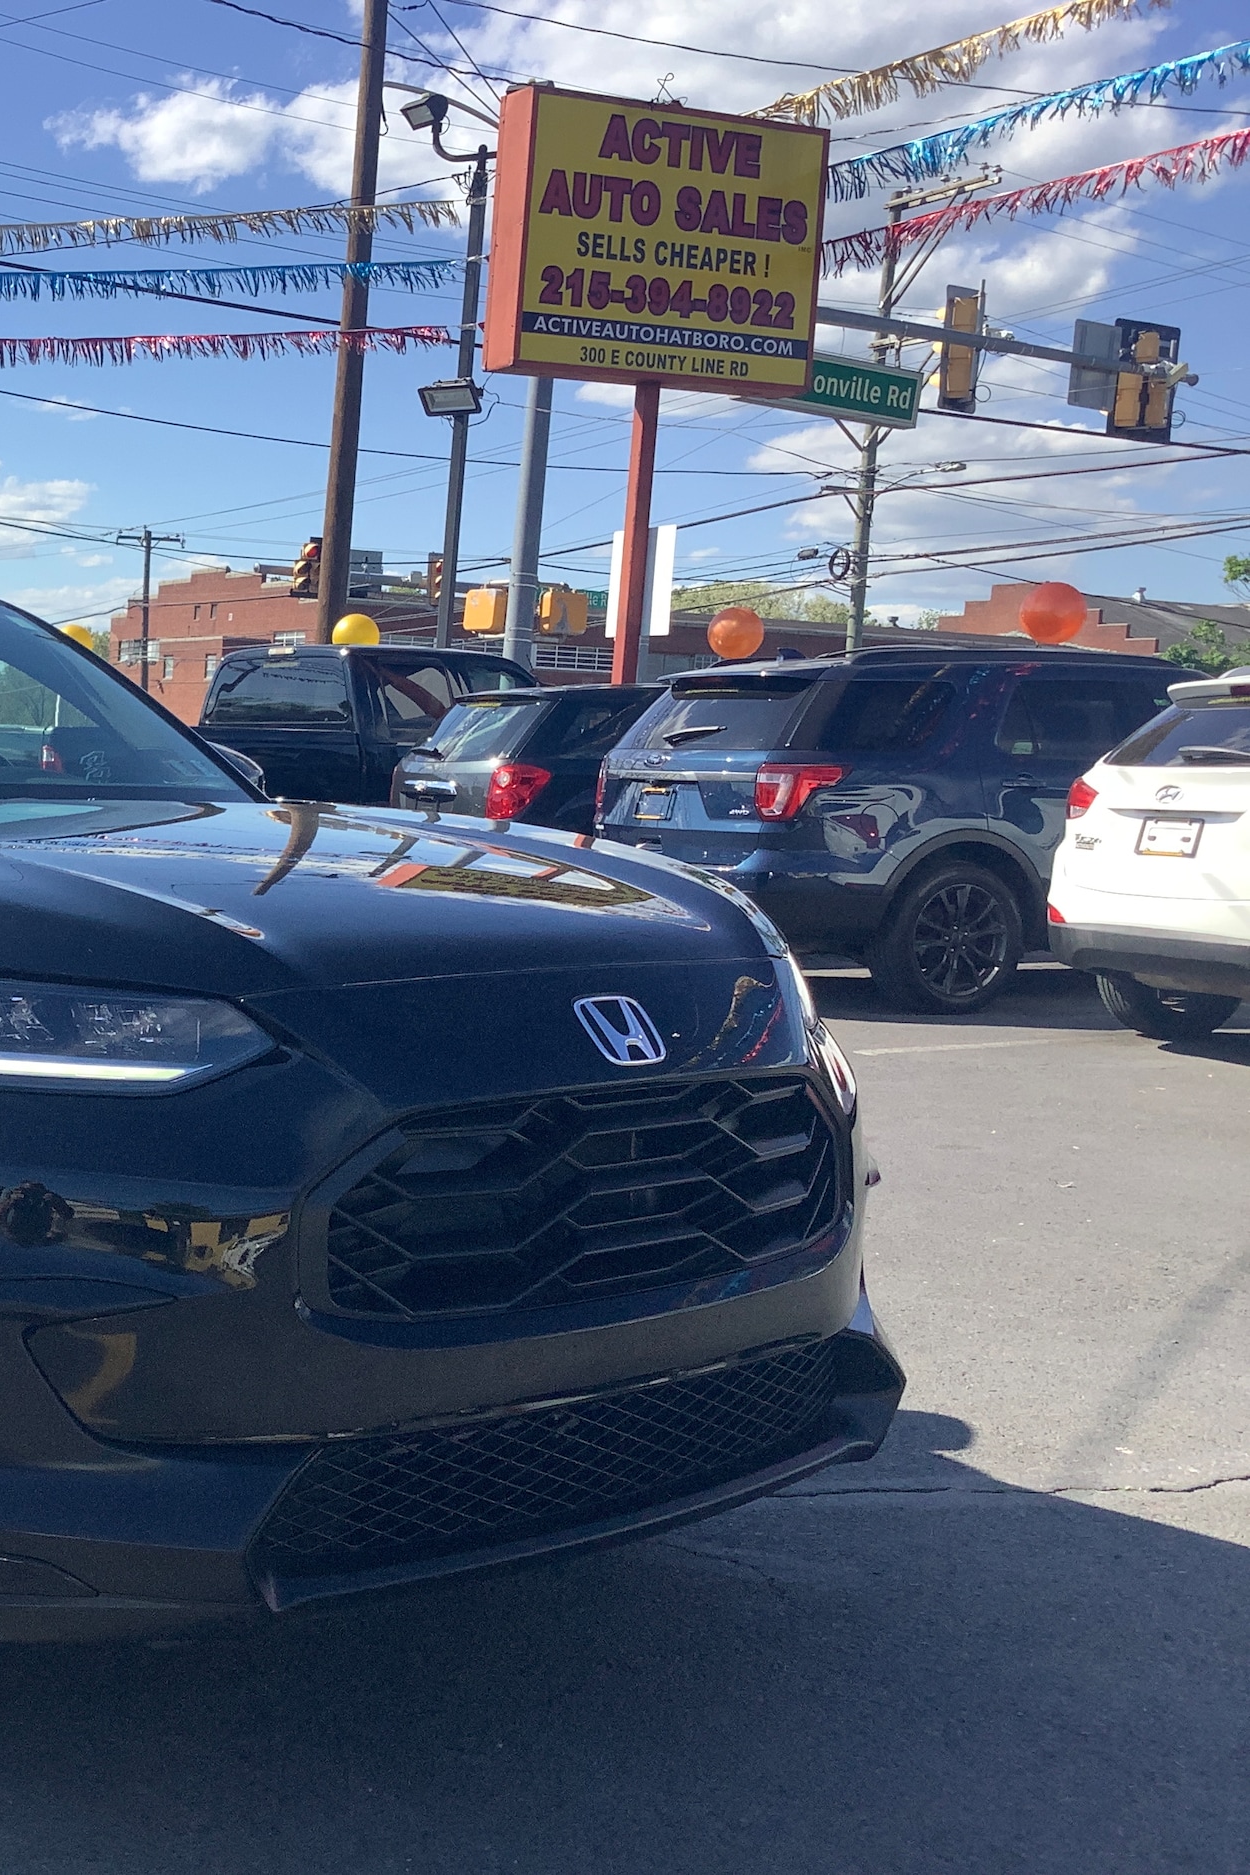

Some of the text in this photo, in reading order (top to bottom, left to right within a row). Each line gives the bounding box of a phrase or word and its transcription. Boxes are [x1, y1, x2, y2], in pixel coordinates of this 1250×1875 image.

[597, 113, 763, 180] ACTIVE
[537, 168, 809, 246] AUTO SALES
[576, 231, 646, 264] SELLS
[654, 240, 757, 277] CHEAPER
[538, 265, 796, 331] 215-394-8922
[533, 315, 794, 357] ACTIVEAUTOHATBORO.COM
[579, 345, 749, 378] 300 E COUNTY LINE RD
[886, 385, 913, 410] Rd
